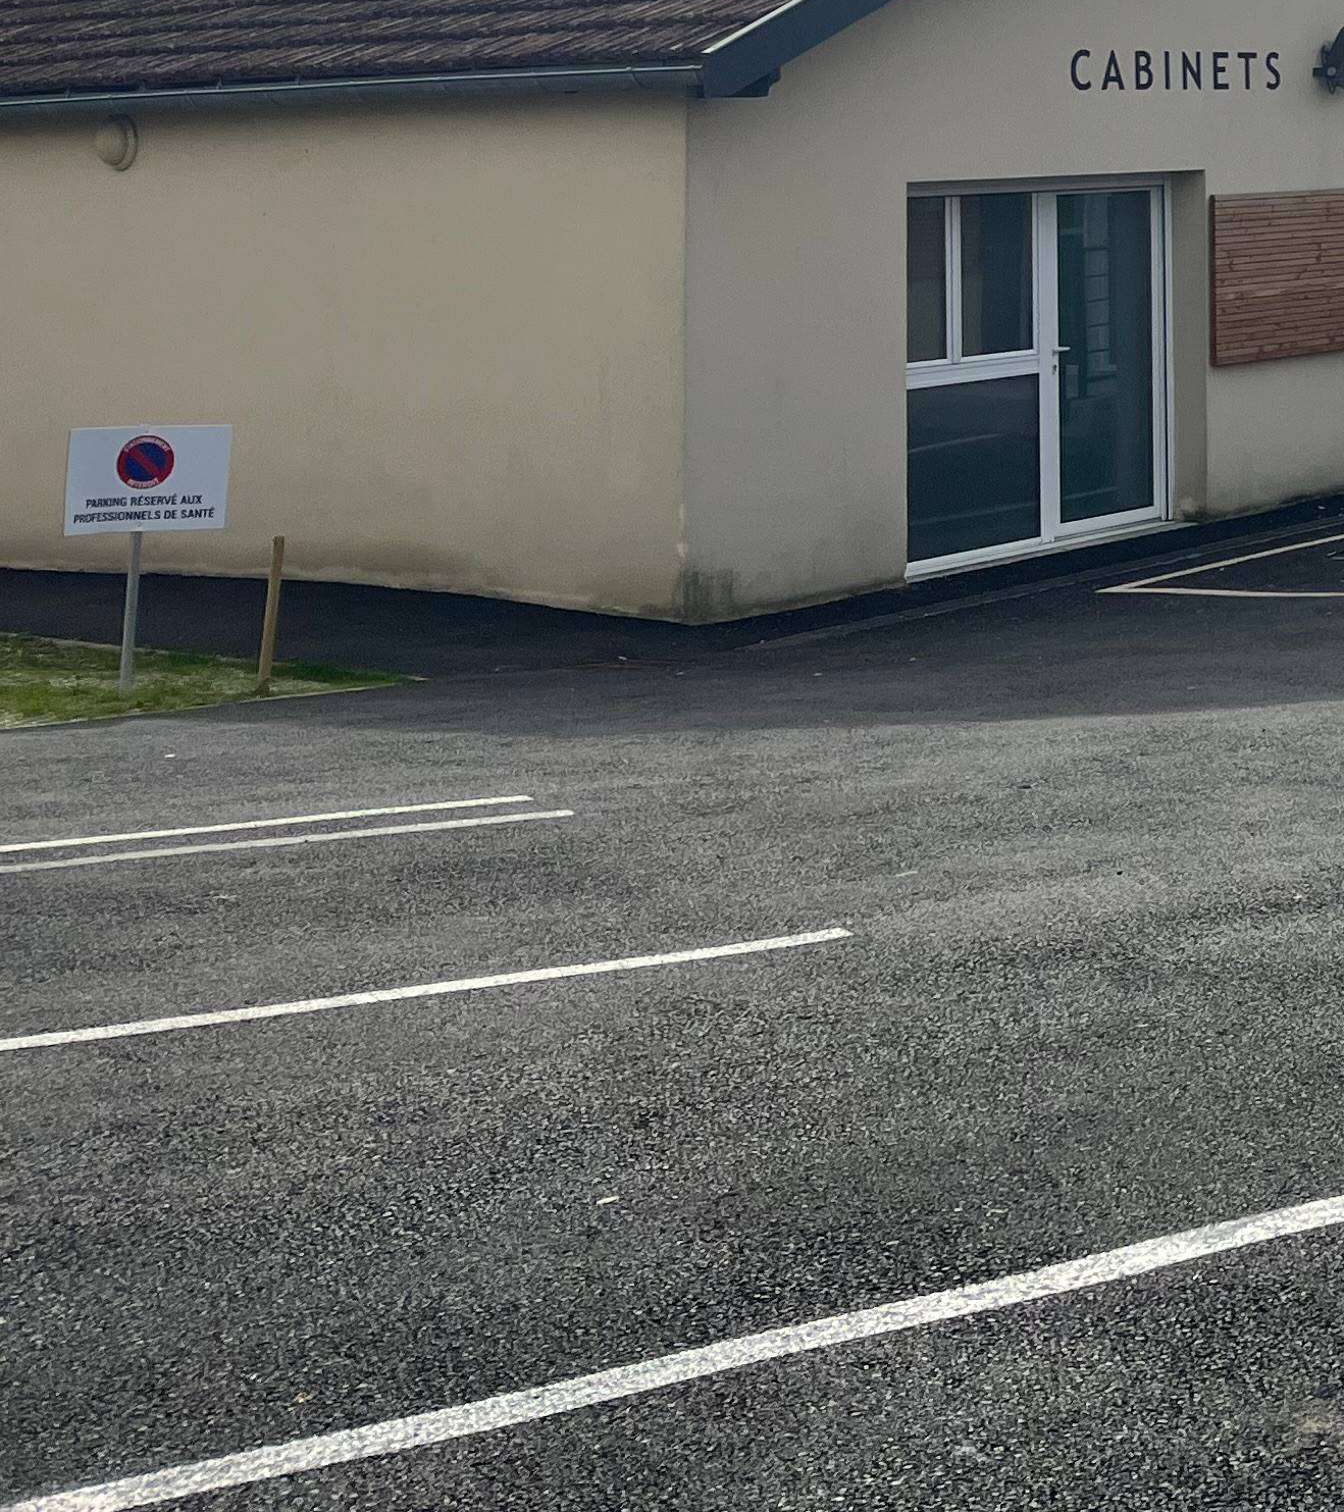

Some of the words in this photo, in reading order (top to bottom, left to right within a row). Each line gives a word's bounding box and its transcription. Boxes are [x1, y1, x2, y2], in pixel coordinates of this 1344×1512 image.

[1070, 49, 1281, 90] CABINETS
[86, 496, 127, 509] PARKING
[130, 493, 177, 506] RÉSERVÉ
[179, 494, 203, 505] AUX
[73, 510, 161, 524] PROFESSIONNELS
[163, 509, 178, 520] DE
[181, 506, 216, 519] SANTÉ
